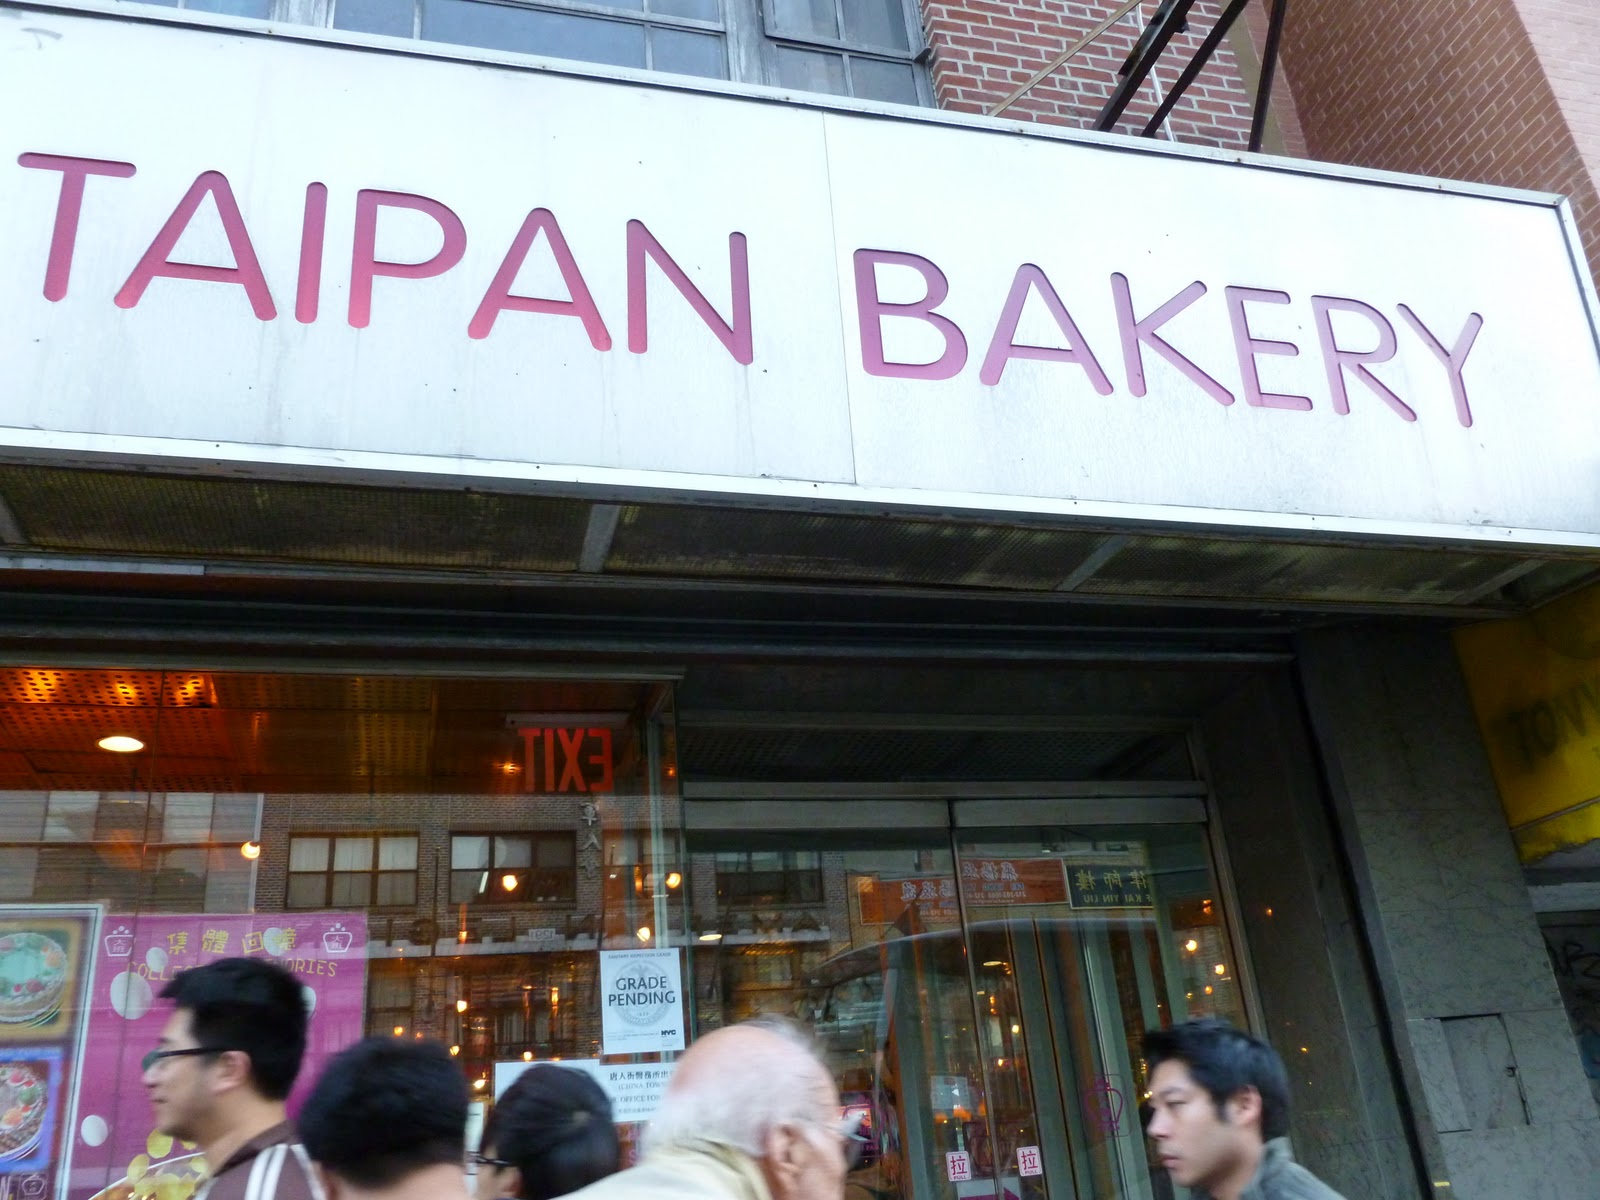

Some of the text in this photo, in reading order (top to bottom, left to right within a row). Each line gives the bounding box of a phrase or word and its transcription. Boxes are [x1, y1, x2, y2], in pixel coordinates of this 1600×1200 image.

[17, 151, 1483, 428] TAIPAN BAKERY
[615, 976, 667, 990] GRADE
[608, 990, 676, 1007] PENDING
[949, 1155, 968, 1176] 拉
[1020, 1150, 1039, 1170] 拉
